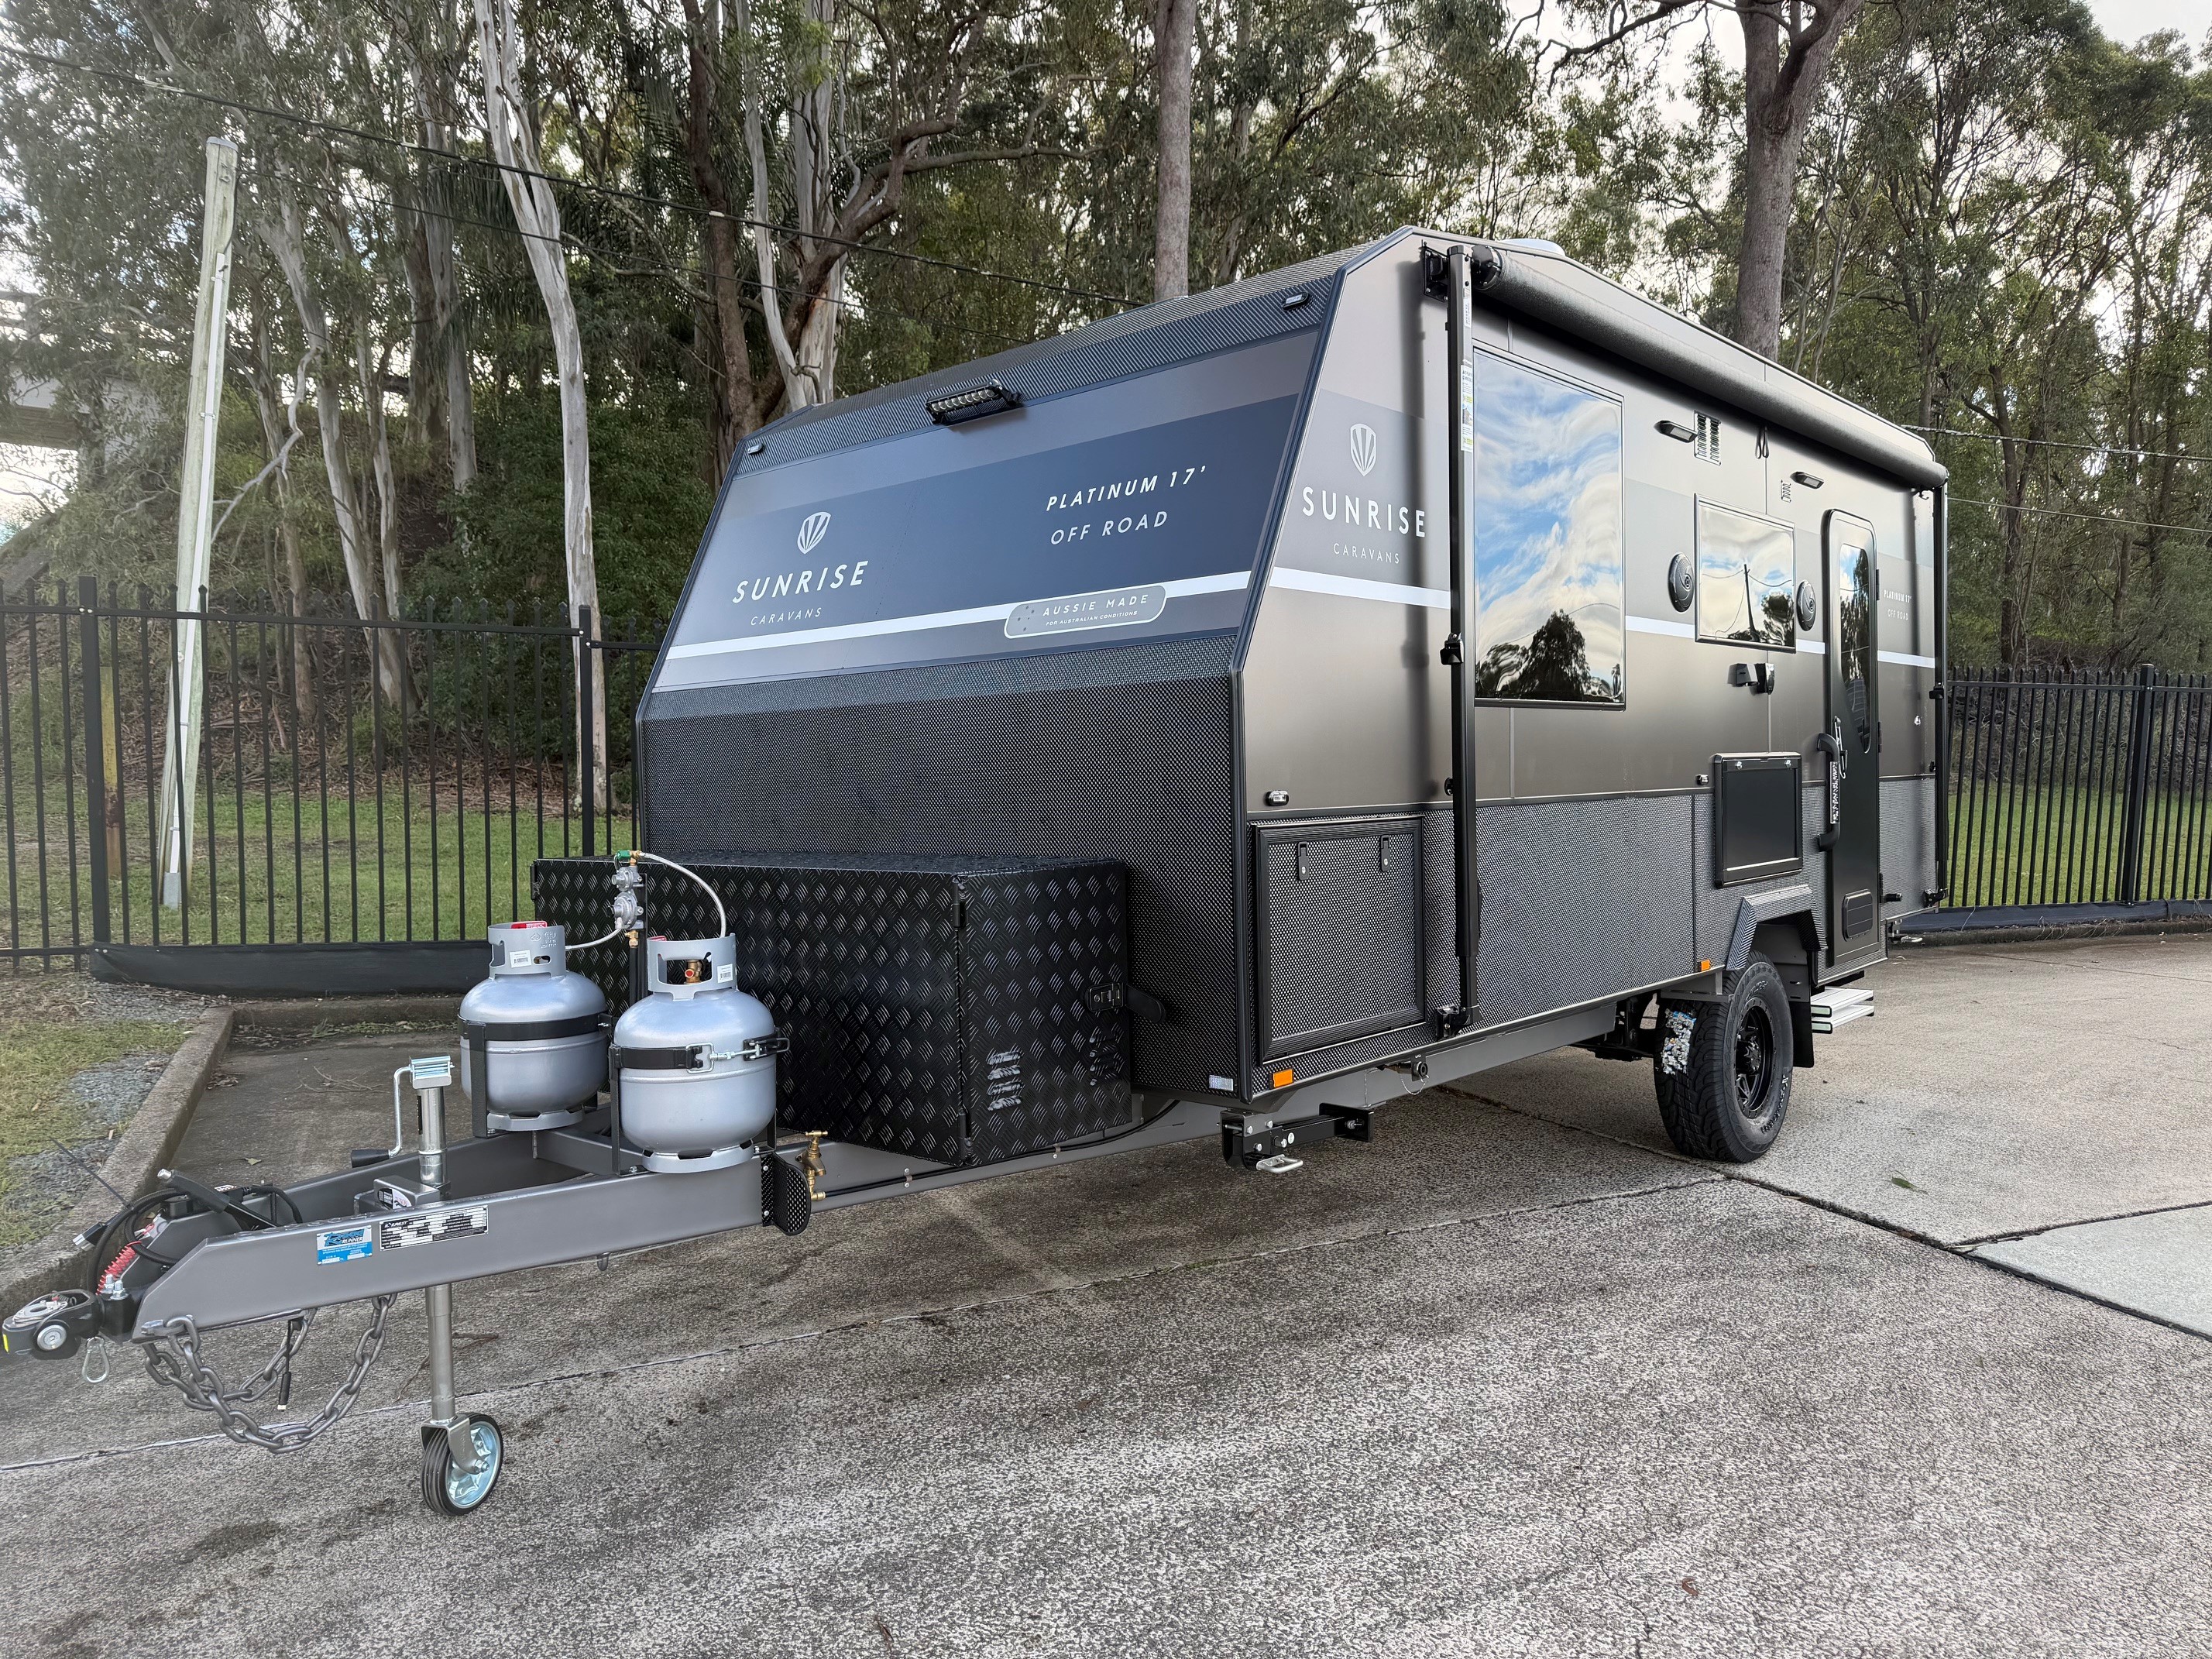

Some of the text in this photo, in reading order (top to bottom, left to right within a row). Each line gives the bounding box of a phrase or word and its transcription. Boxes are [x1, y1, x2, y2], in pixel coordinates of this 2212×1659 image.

[1046, 475, 1157, 512] PLATINUM
[1302, 486, 1426, 538] SUNRISE
[1050, 510, 1168, 545] OFF ROAD
[1333, 543, 1400, 565] CARAVANS
[732, 560, 869, 604] SUNRISE
[750, 606, 823, 627] CARAVANS
[1042, 594, 1149, 617] AUSSIE MADE
[1059, 615, 1098, 624] AUSTRALIAN
[1099, 610, 1139, 620] CONDITIONS
